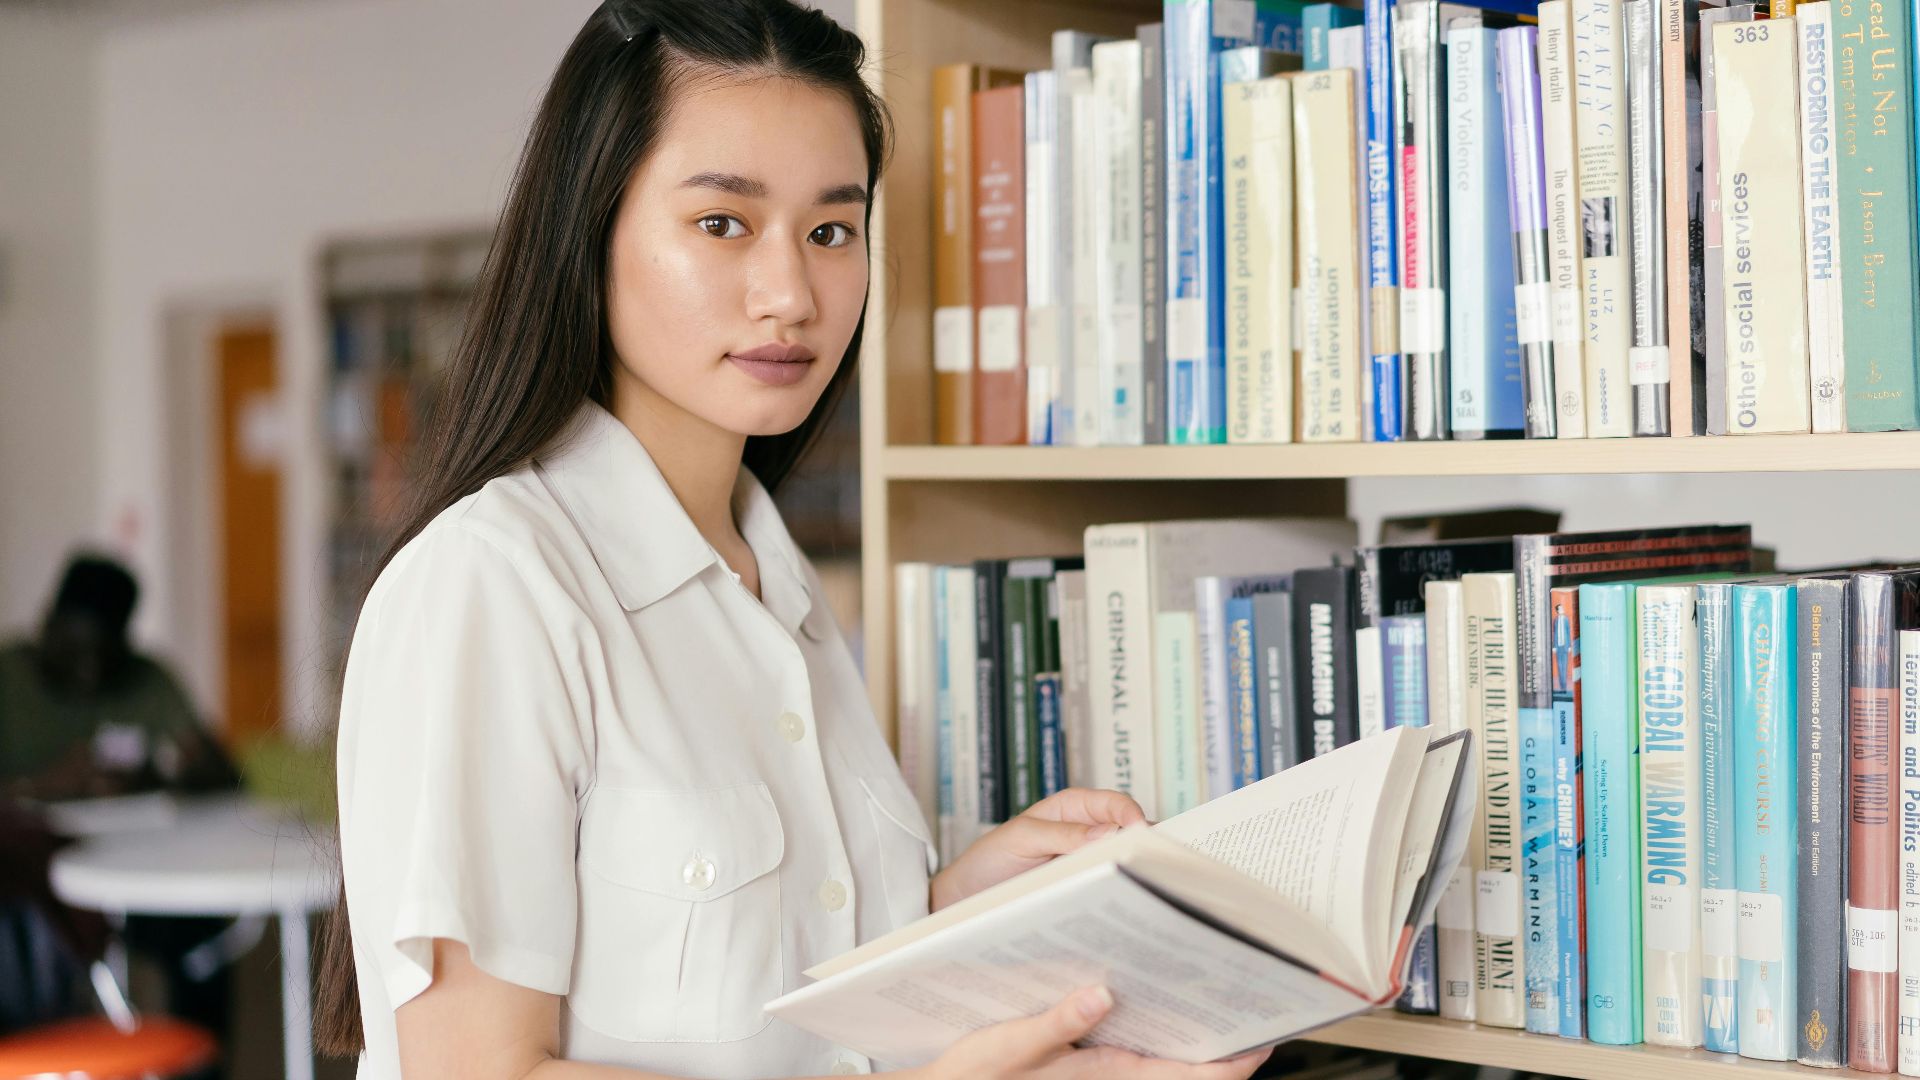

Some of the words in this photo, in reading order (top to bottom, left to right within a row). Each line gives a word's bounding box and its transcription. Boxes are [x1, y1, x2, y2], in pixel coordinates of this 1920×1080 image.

[1669, 9, 1680, 43] POVERTY
[1734, 24, 1769, 43] 363
[1840, 0, 1857, 17] o
[1870, 0, 1890, 39] ead
[1454, 40, 1472, 103] Dating
[1545, 28, 1561, 62] Henry
[1576, 12, 1594, 111] NIGHT
[1871, 48, 1895, 81] Us
[1549, 67, 1562, 103] Hazlitt
[1806, 22, 1829, 154] RESTORING
[1841, 24, 1864, 158] Temptation
[1870, 90, 1897, 136] Not
[1457, 109, 1472, 192] Violence
[1811, 157, 1830, 199] THE
[1554, 169, 1567, 189] The
[1231, 177, 1252, 278] problems
[1553, 194, 1568, 244] Conquest
[1732, 171, 1751, 273] services
[1812, 205, 1832, 280] EARTH
[1859, 189, 1884, 244] Jason
[1557, 249, 1570, 260] of
[1859, 254, 1885, 308] Berry
[1233, 286, 1249, 349] social
[1325, 267, 1340, 379] alleviation
[1589, 268, 1599, 343] MURRAY
[1603, 288, 1612, 313] LIZ
[1733, 282, 1753, 351] social
[1232, 357, 1249, 439] General
[1255, 350, 1273, 439] services
[1306, 371, 1321, 437] Social
[1327, 389, 1340, 413] its
[1738, 360, 1757, 428] Other
[1107, 591, 1129, 714] CRIMINAL
[1467, 615, 1479, 689] GREENBERG
[1483, 617, 1505, 684] PUBLIC
[1643, 604, 1661, 661] Schneider
[1703, 617, 1717, 635] The
[1811, 604, 1822, 647] Siebert
[1310, 603, 1334, 715] MANAGING
[1702, 646, 1717, 700] Shaping
[1756, 623, 1771, 741] CHANGING
[1811, 652, 1822, 714] Economics
[1644, 666, 1685, 754] GLOBAL
[1703, 704, 1718, 718] of
[1904, 654, 1920, 734] Terrorism
[1485, 688, 1509, 761] HEALTH
[1811, 717, 1822, 730] of
[1811, 732, 1822, 749] the
[1487, 768, 1511, 807] AND
[1524, 737, 1538, 824] GLOBAL
[1556, 757, 1568, 780] why
[1599, 759, 1608, 787] Scaling
[1703, 722, 1719, 847] Environmentalism
[1811, 753, 1822, 824] Environment
[1905, 746, 1920, 778] and
[1558, 783, 1575, 848] CRIME?
[1600, 804, 1609, 832] Scaling
[1756, 749, 1771, 836] COURSE
[1853, 773, 1889, 825] WORLD
[1904, 789, 1920, 851] Politics
[1487, 811, 1511, 850] THE
[1645, 761, 1687, 886] WARMING
[1811, 831, 1820, 846] 3rd
[1706, 852, 1721, 865] in
[1811, 847, 1820, 876] Edition
[1905, 862, 1919, 895] edited
[1527, 836, 1541, 943] WARMING
[1852, 929, 1886, 941] 364.106
[1852, 938, 1865, 948] STE
